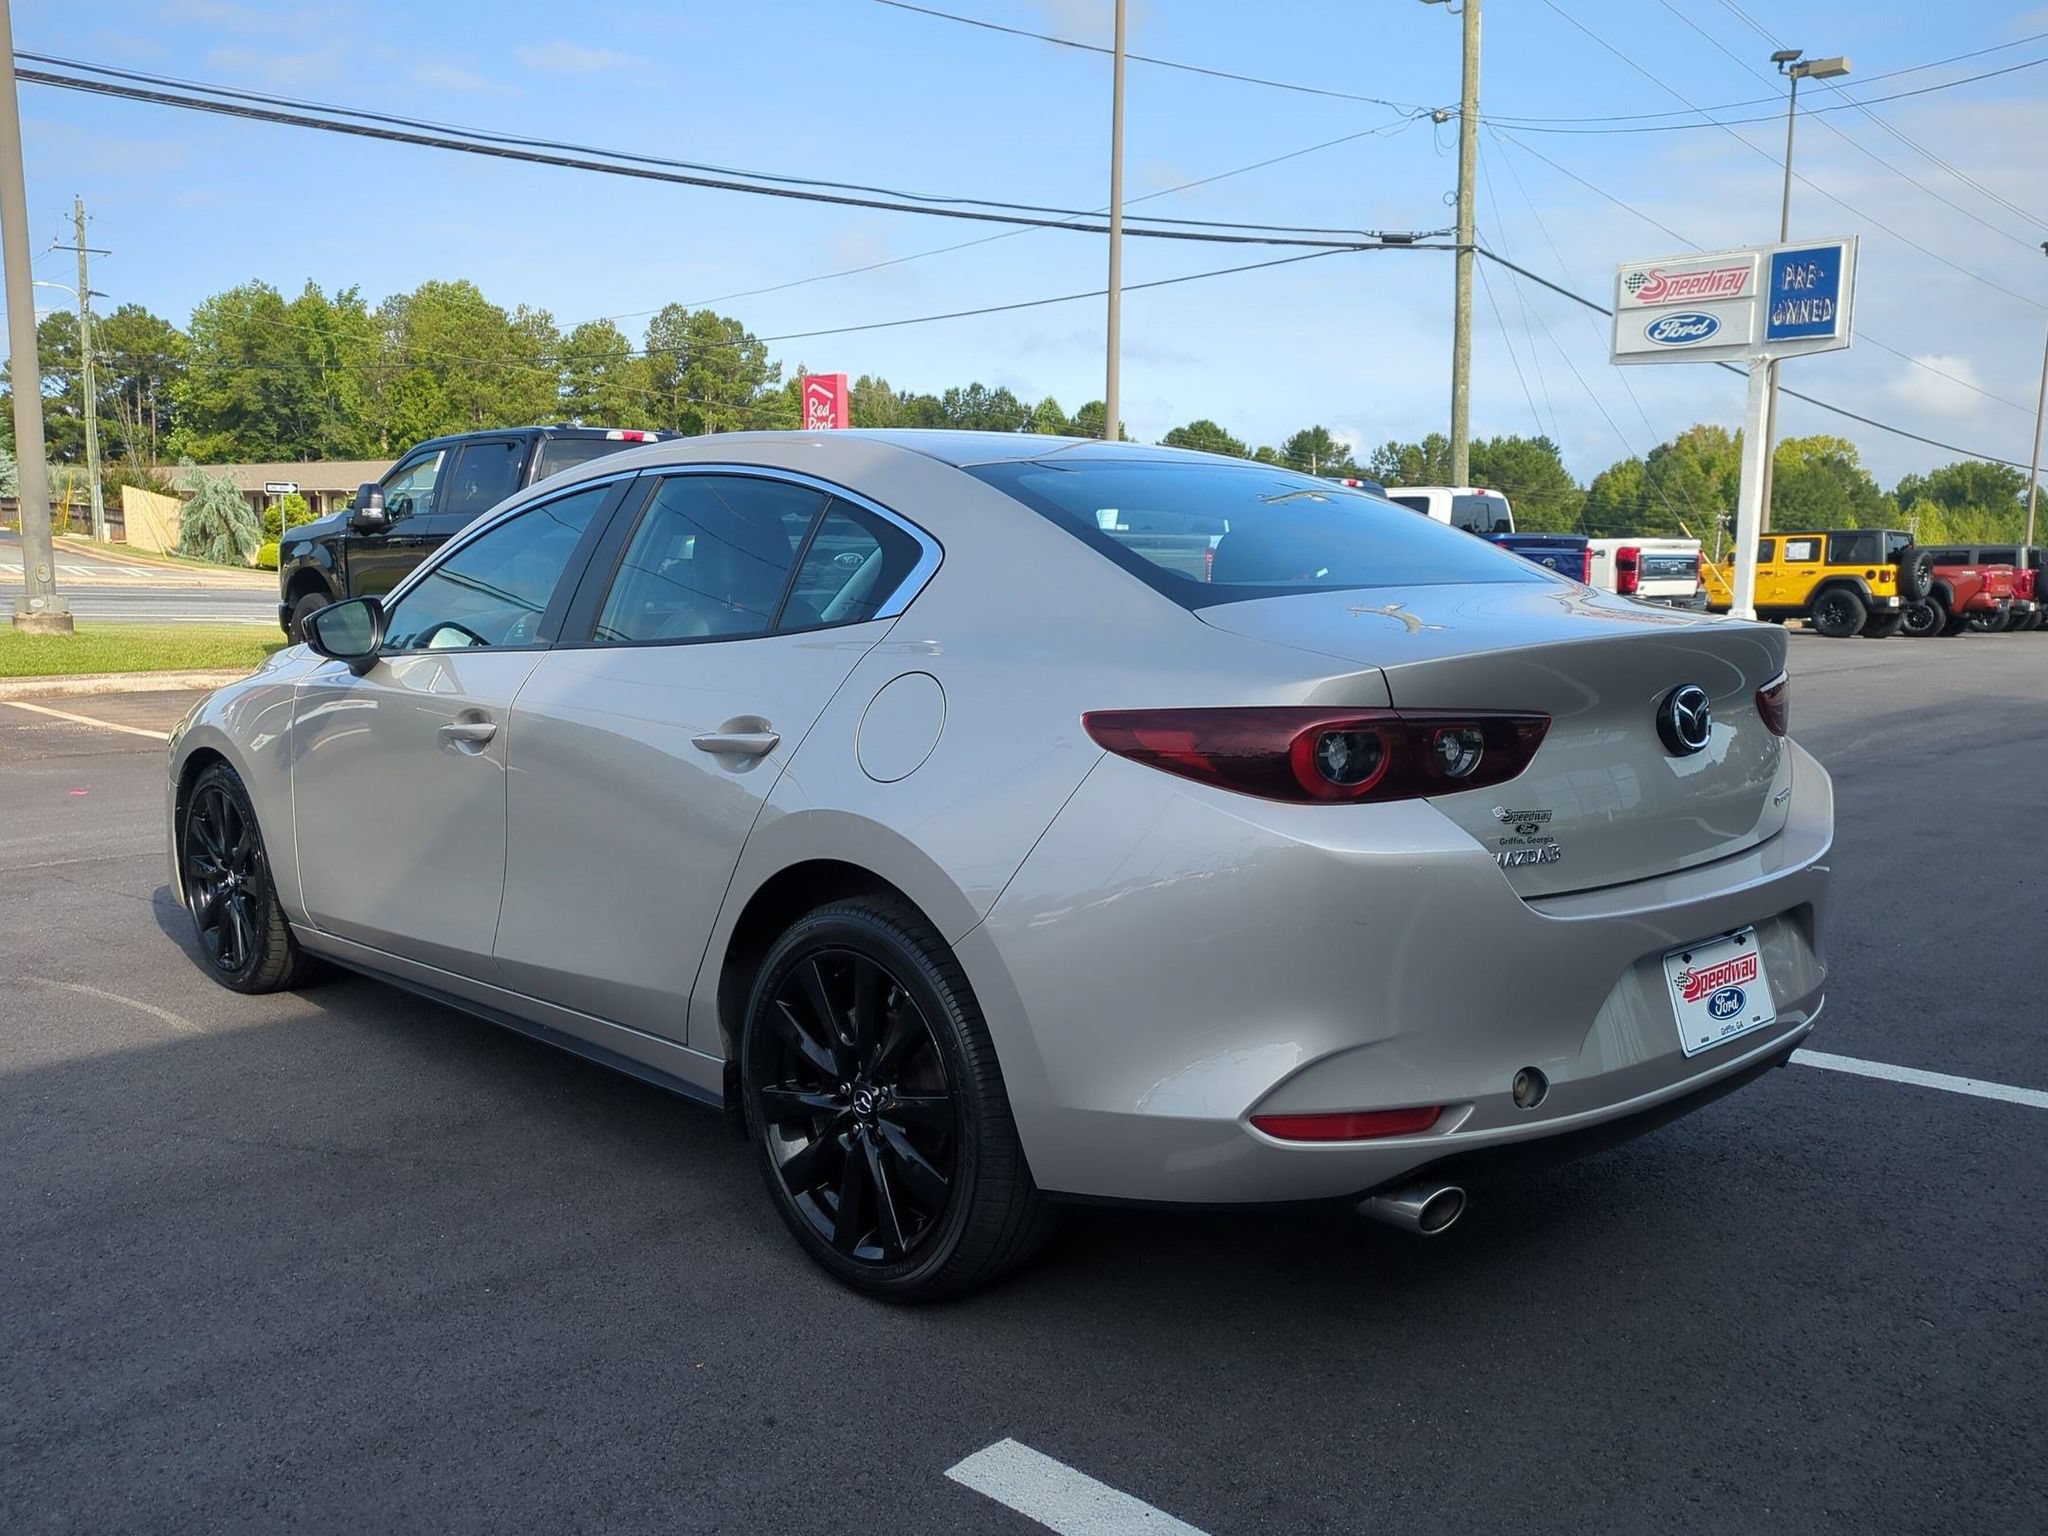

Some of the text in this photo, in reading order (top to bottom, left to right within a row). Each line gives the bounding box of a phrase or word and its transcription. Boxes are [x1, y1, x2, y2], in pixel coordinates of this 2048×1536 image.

[1636, 267, 1751, 303] Speedway
[1654, 318, 1709, 339] Ford
[809, 397, 831, 417] Red
[1501, 809, 1552, 824] Speedway
[1500, 835, 1554, 846] Griffin, Georgia
[1683, 953, 1757, 1002] Speedway
[1715, 991, 1740, 1016] Ford
